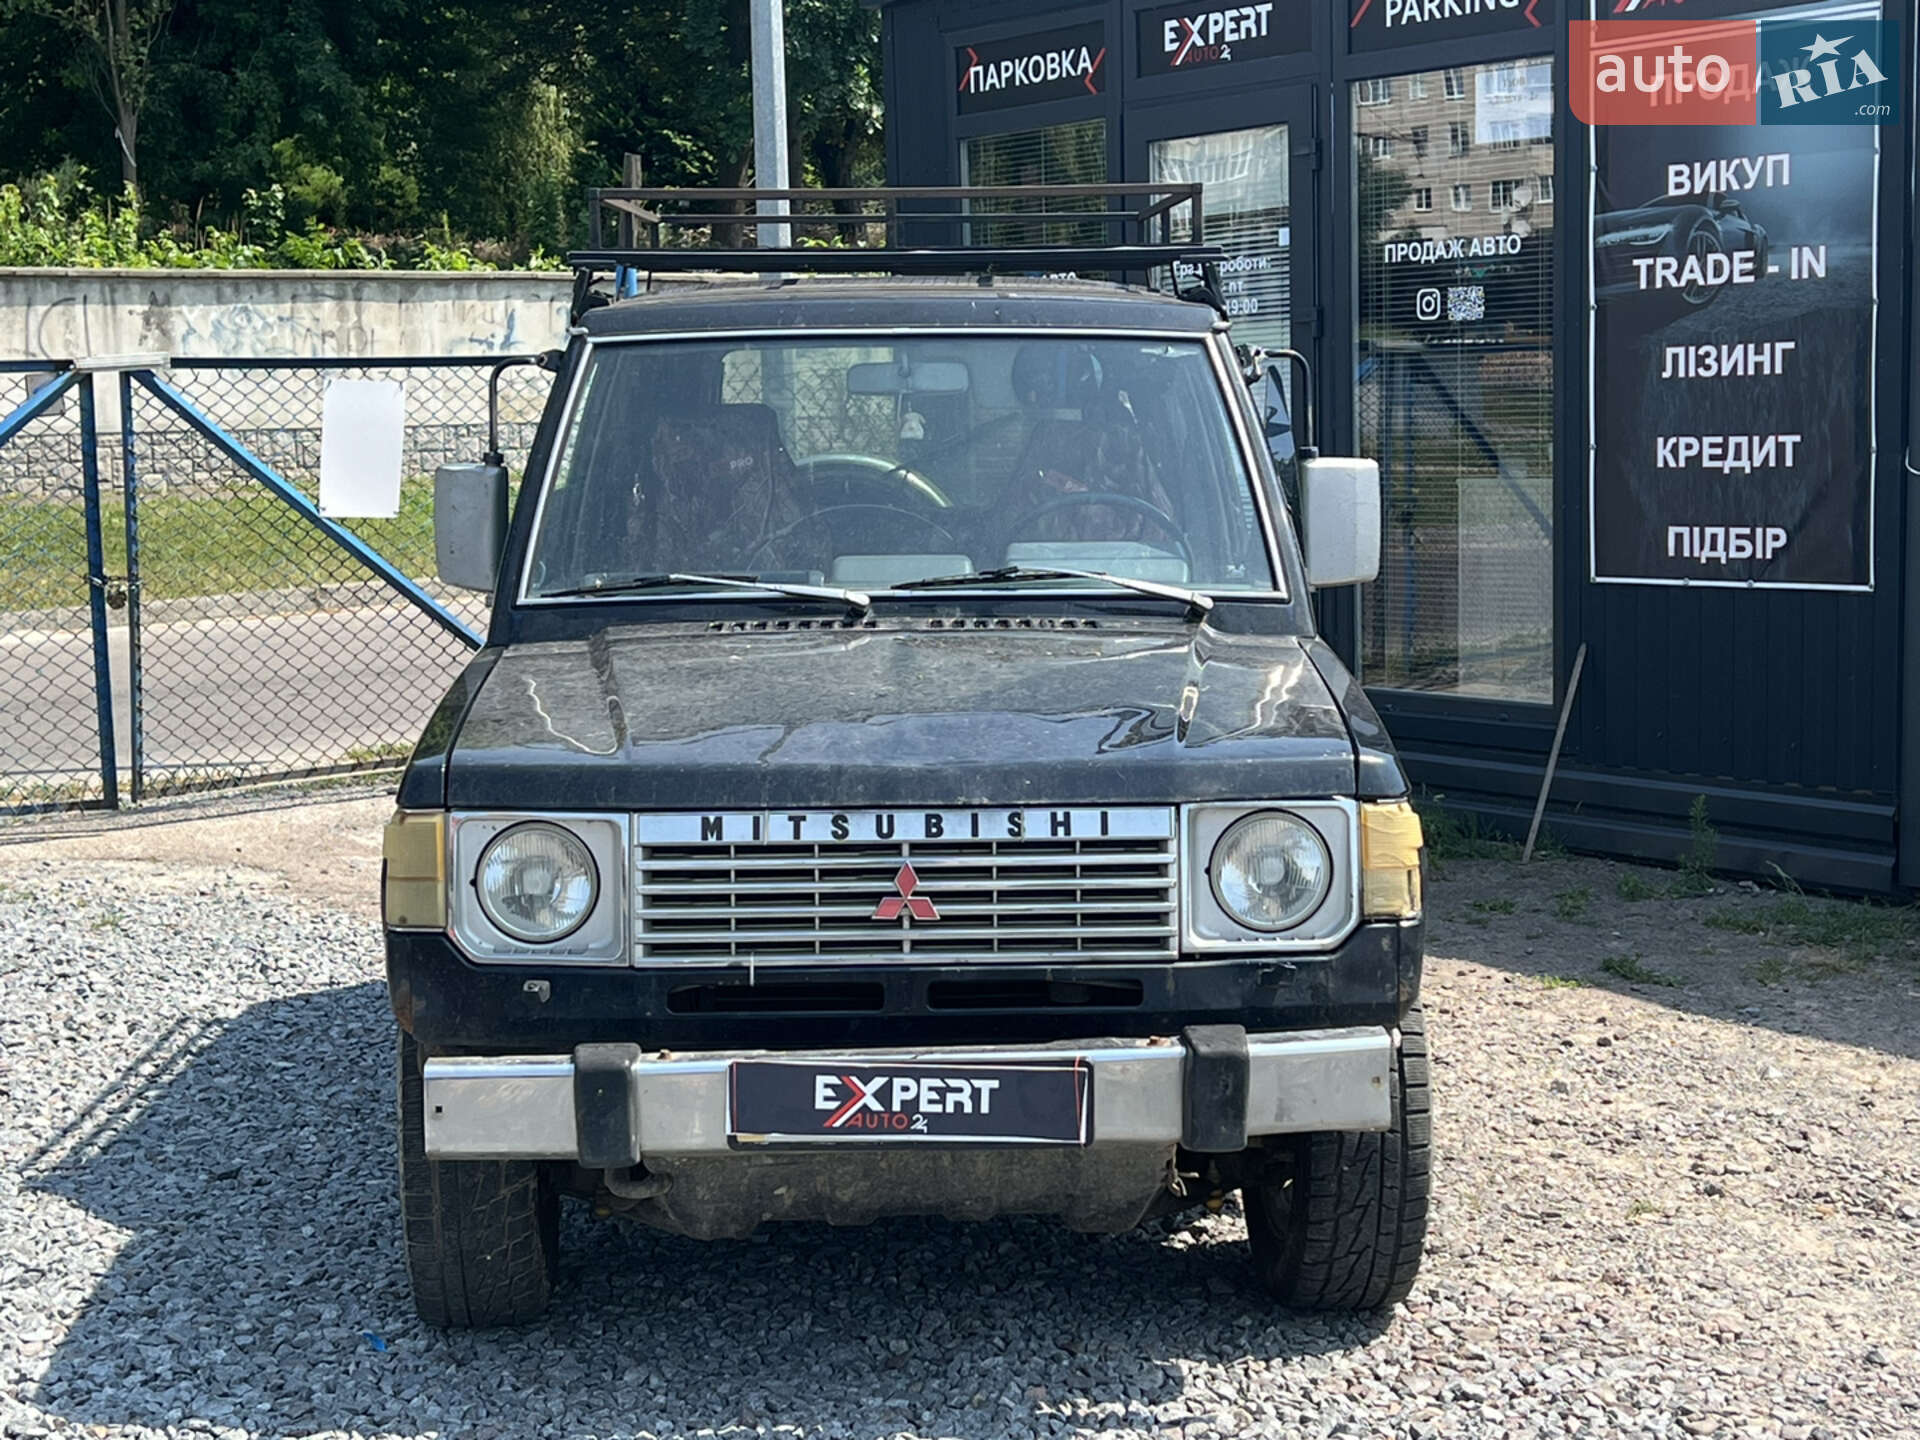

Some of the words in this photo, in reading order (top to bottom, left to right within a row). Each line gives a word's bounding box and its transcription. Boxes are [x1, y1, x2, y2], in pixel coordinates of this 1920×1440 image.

[1386, 0, 1519, 27] PARK
[1164, 3, 1273, 66] EXPERT
[970, 46, 1094, 93] ПАРКОВКА
[1667, 153, 1790, 196] ВИКУП
[1384, 238, 1464, 264] ПРОДАЖ
[1469, 234, 1521, 257] АВТО
[1632, 250, 1755, 290] TRADE
[1790, 245, 1827, 280] IN
[1661, 341, 1796, 378] ЛІЗИНГ
[1656, 434, 1801, 474] КРЕДИТ
[1667, 525, 1787, 564] ПІДБІР
[701, 810, 1110, 841] MITSUBISHI
[815, 1074, 1000, 1128] EXPERT
